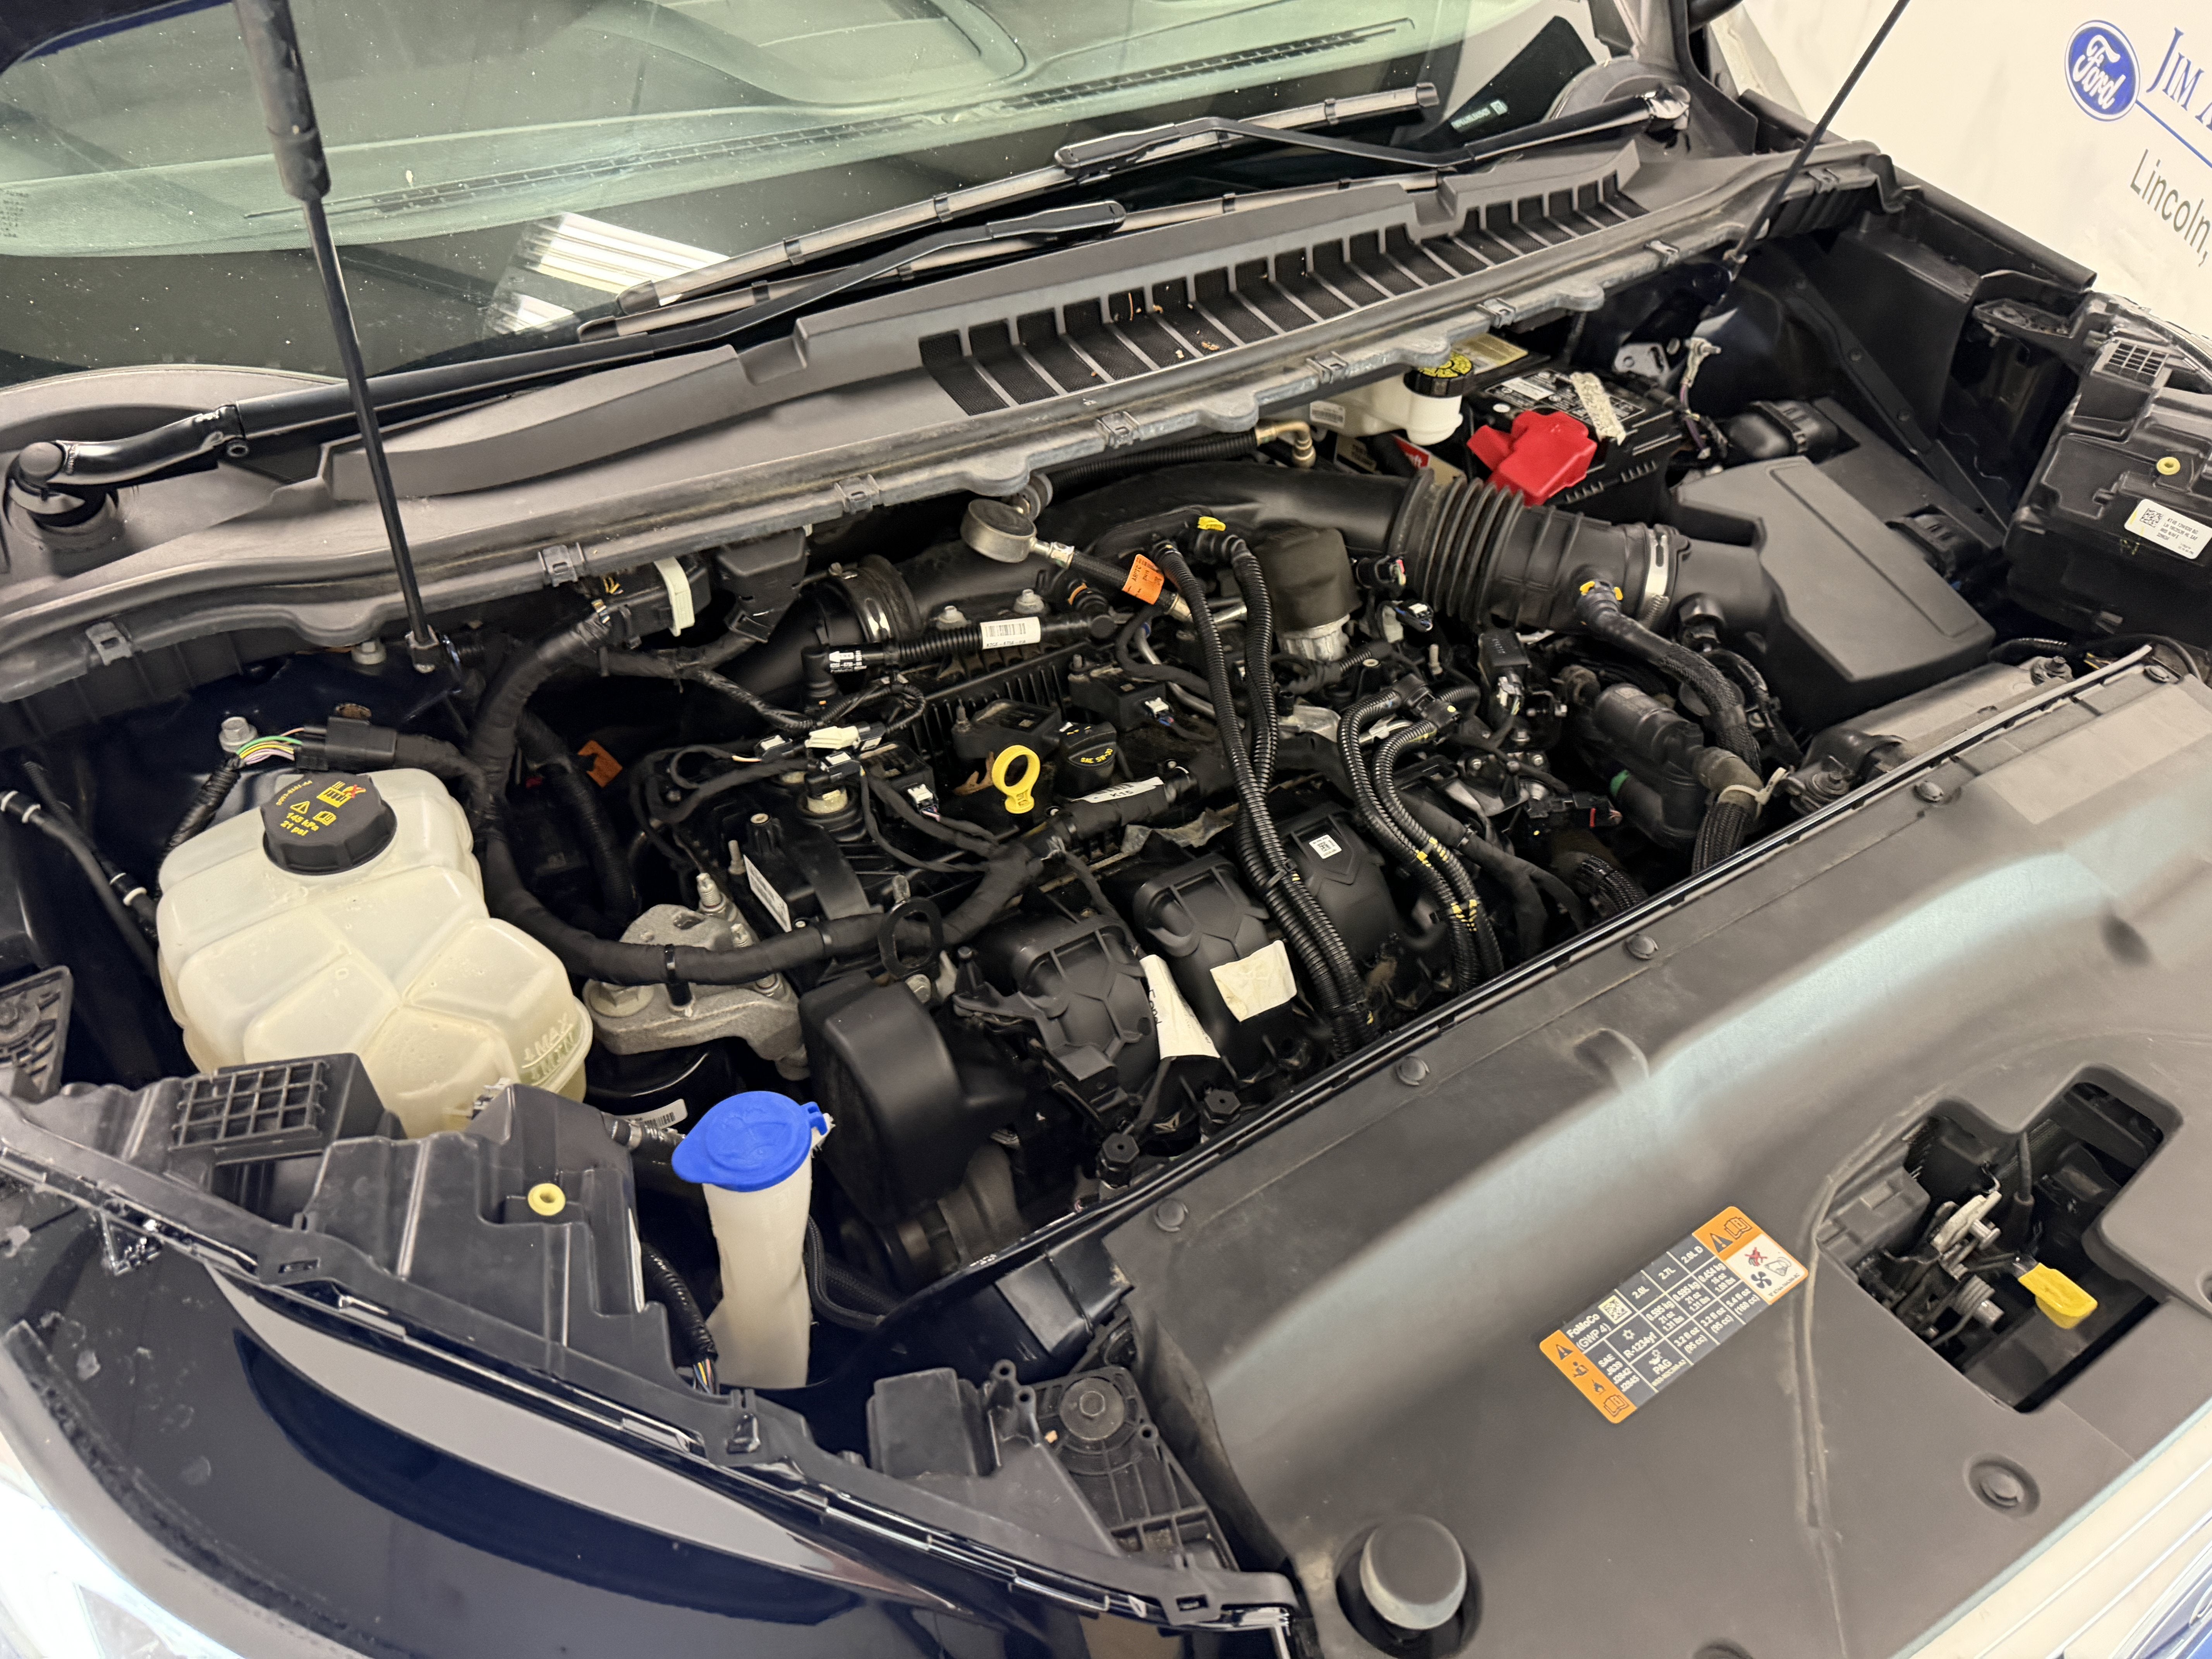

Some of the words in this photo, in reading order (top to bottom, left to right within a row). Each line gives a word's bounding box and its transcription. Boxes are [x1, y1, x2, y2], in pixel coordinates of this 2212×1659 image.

[2072, 34, 2126, 110] Ford
[2146, 26, 2205, 112] JIM
[2130, 148, 2212, 268] Lincoln,
[1096, 748, 1113, 762] 5W-30
[280, 820, 294, 830] 21
[290, 827, 309, 836] psi
[286, 812, 304, 823] 145
[301, 819, 319, 831] kPa
[534, 1012, 567, 1056] MAX
[541, 1031, 574, 1075] MIN
[1681, 1249, 1698, 1263] 2.0L
[1713, 1259, 1726, 1271] kg
[1658, 1267, 1676, 1279] 2.7L
[1688, 1278, 1700, 1290] kg
[1632, 1286, 1649, 1298] 2.0L
[1661, 1297, 1674, 1309] kg
[1726, 1297, 1738, 1309] 5.4
[1748, 1295, 1760, 1304] cc)
[1566, 1314, 1600, 1338] FoMoCo
[1658, 1316, 1668, 1324] 21
[1700, 1316, 1713, 1326] 3.2
[1721, 1315, 1734, 1325] cc)
[1577, 1329, 1599, 1350] (GWP
[1600, 1323, 1611, 1332] 4)
[1674, 1336, 1686, 1346] 3.2
[1695, 1335, 1707, 1345] cc)
[1623, 1332, 1657, 1358] R-1234yf
[1598, 1354, 1615, 1367] SAE
[1652, 1359, 1672, 1374] PAG
